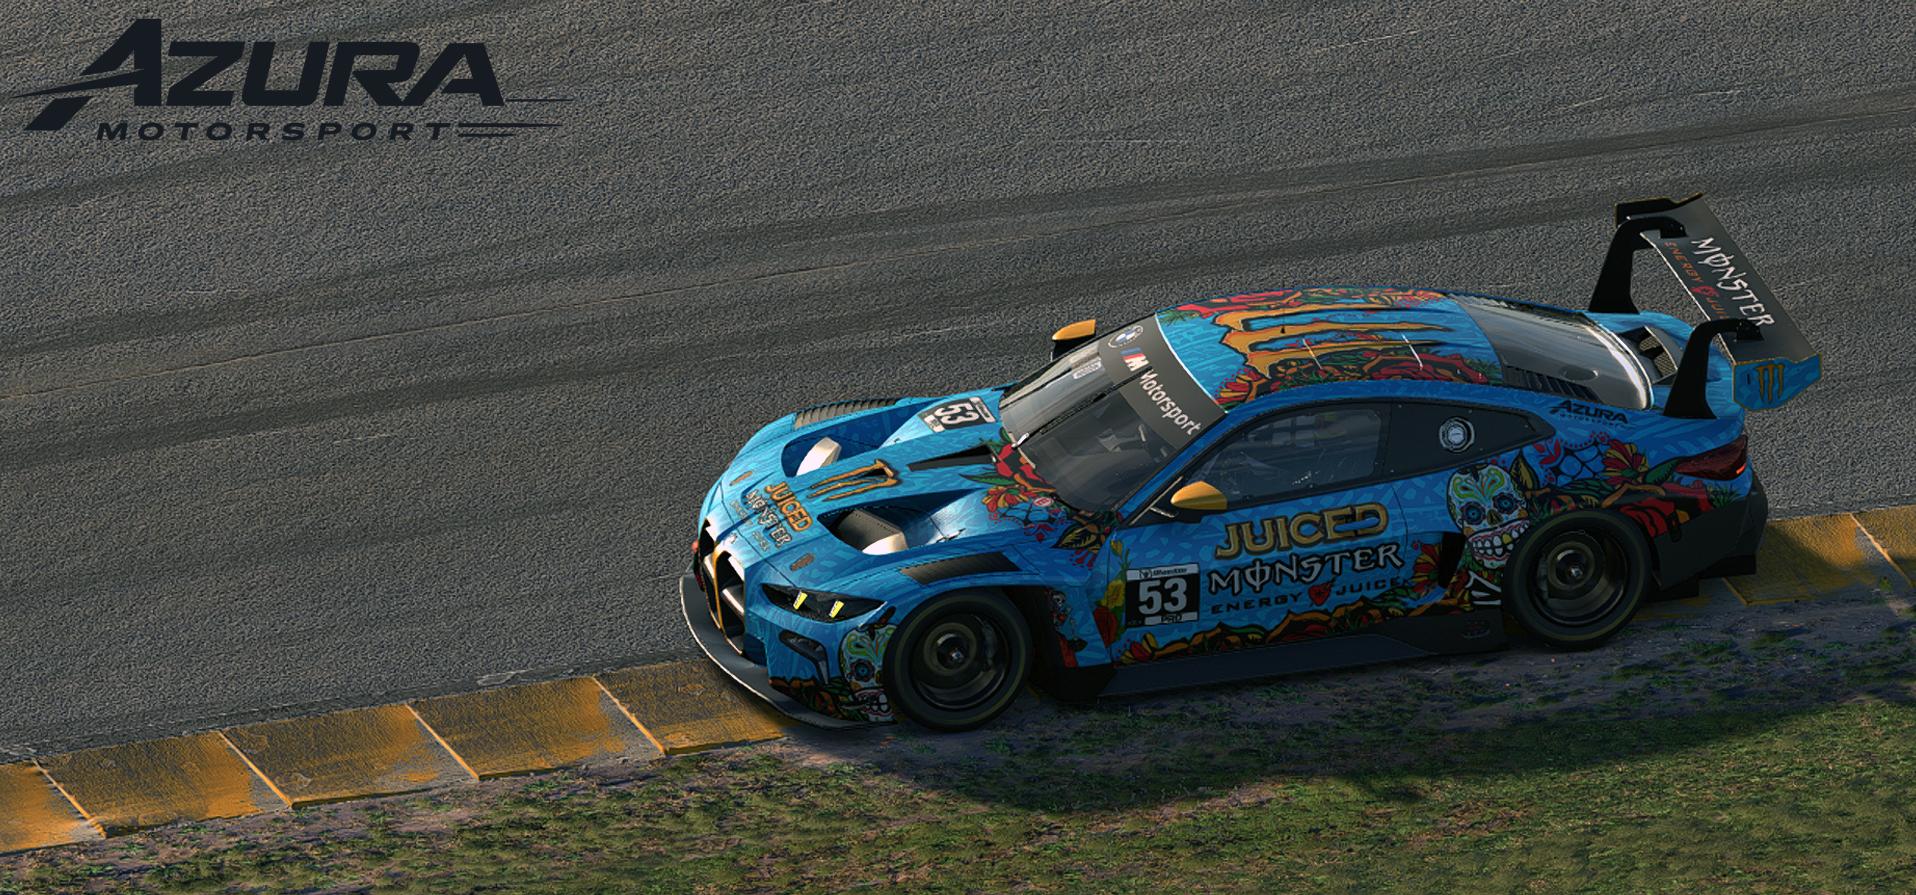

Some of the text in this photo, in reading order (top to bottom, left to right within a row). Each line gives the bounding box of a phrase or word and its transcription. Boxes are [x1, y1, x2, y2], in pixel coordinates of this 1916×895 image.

[934, 402, 980, 425] 53
[1140, 368, 1202, 435] Motorsport
[1551, 400, 1629, 424] AZURA
[765, 482, 813, 532] JUICED
[1215, 503, 1388, 558] JUICED
[1138, 577, 1187, 615] 53
[1211, 592, 1303, 614] ENERGY
